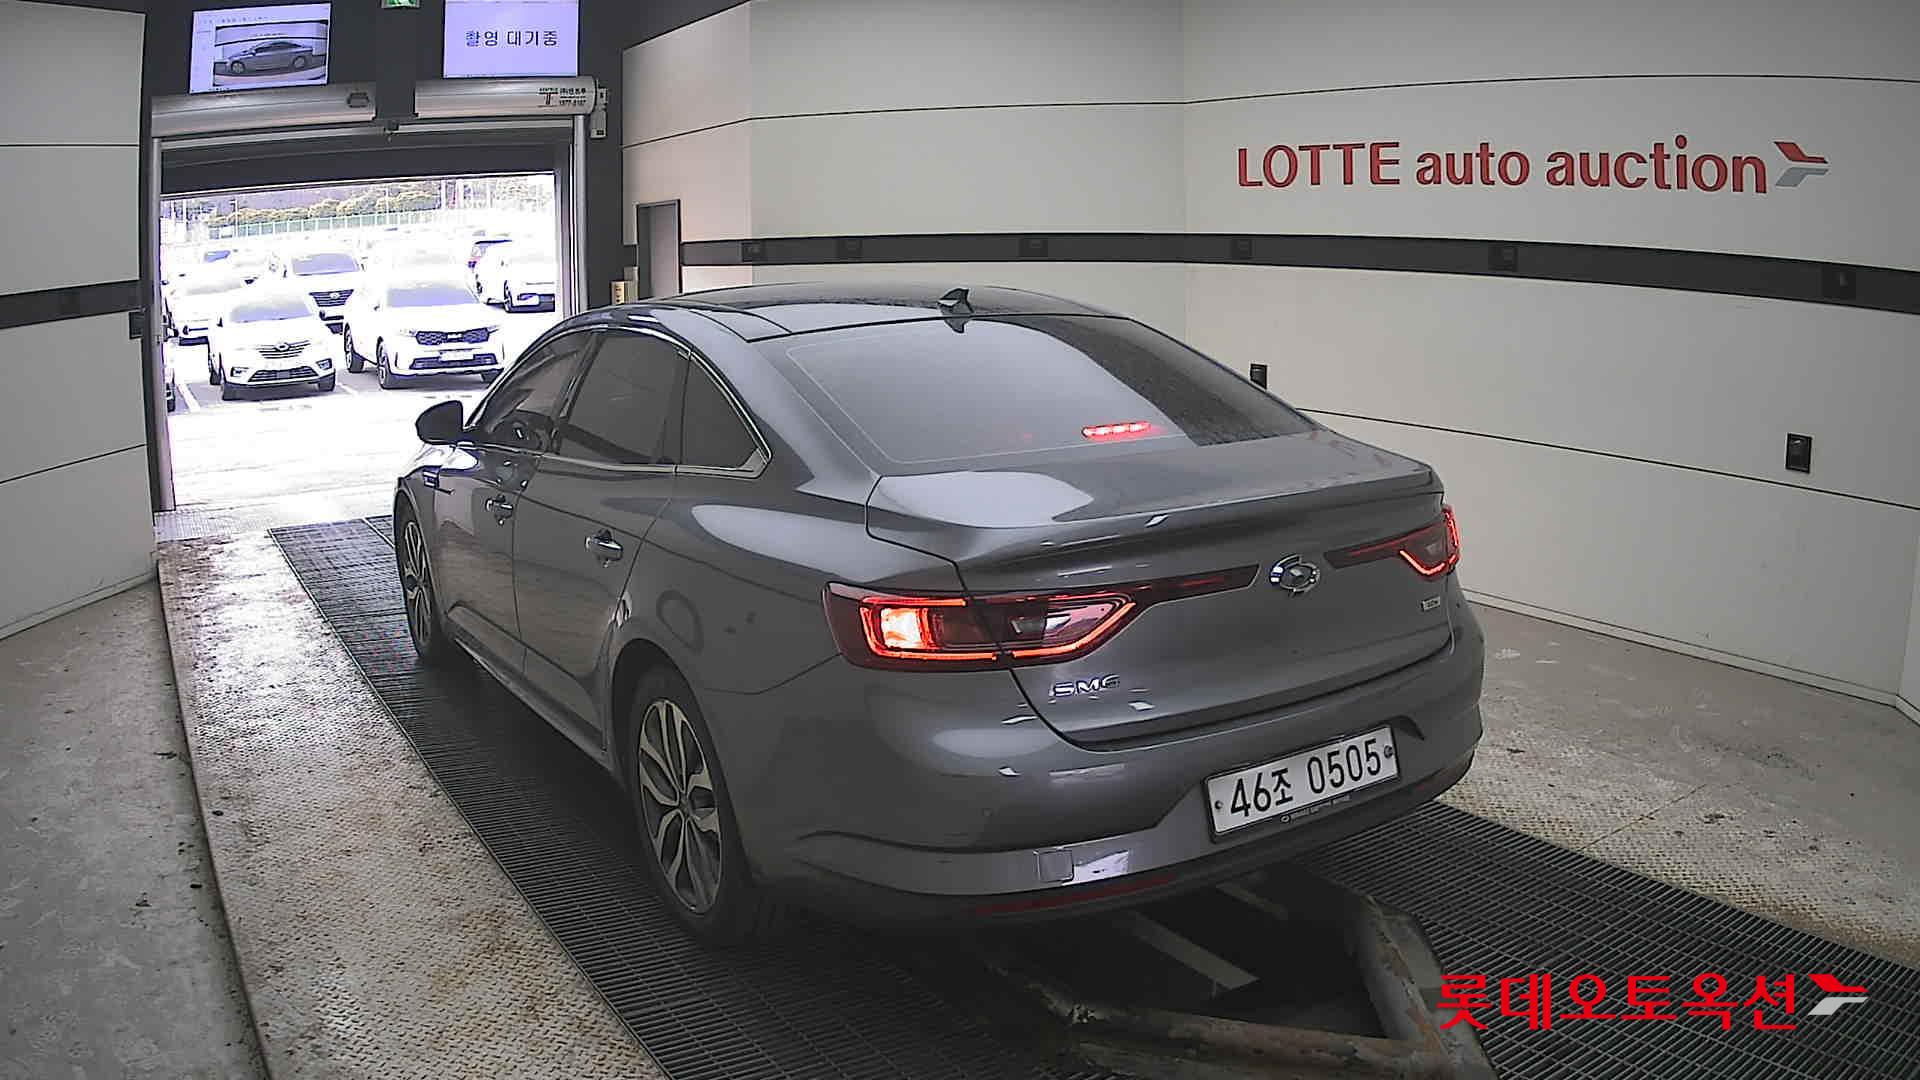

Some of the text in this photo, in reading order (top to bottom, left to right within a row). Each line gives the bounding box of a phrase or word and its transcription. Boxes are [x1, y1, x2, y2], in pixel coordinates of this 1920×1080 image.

[465, 30, 558, 47] 촬영 대기중
[1237, 134, 1768, 195] LOTTE auto auction
[1230, 768, 1294, 817] 46조
[1307, 738, 1382, 794] 0505
